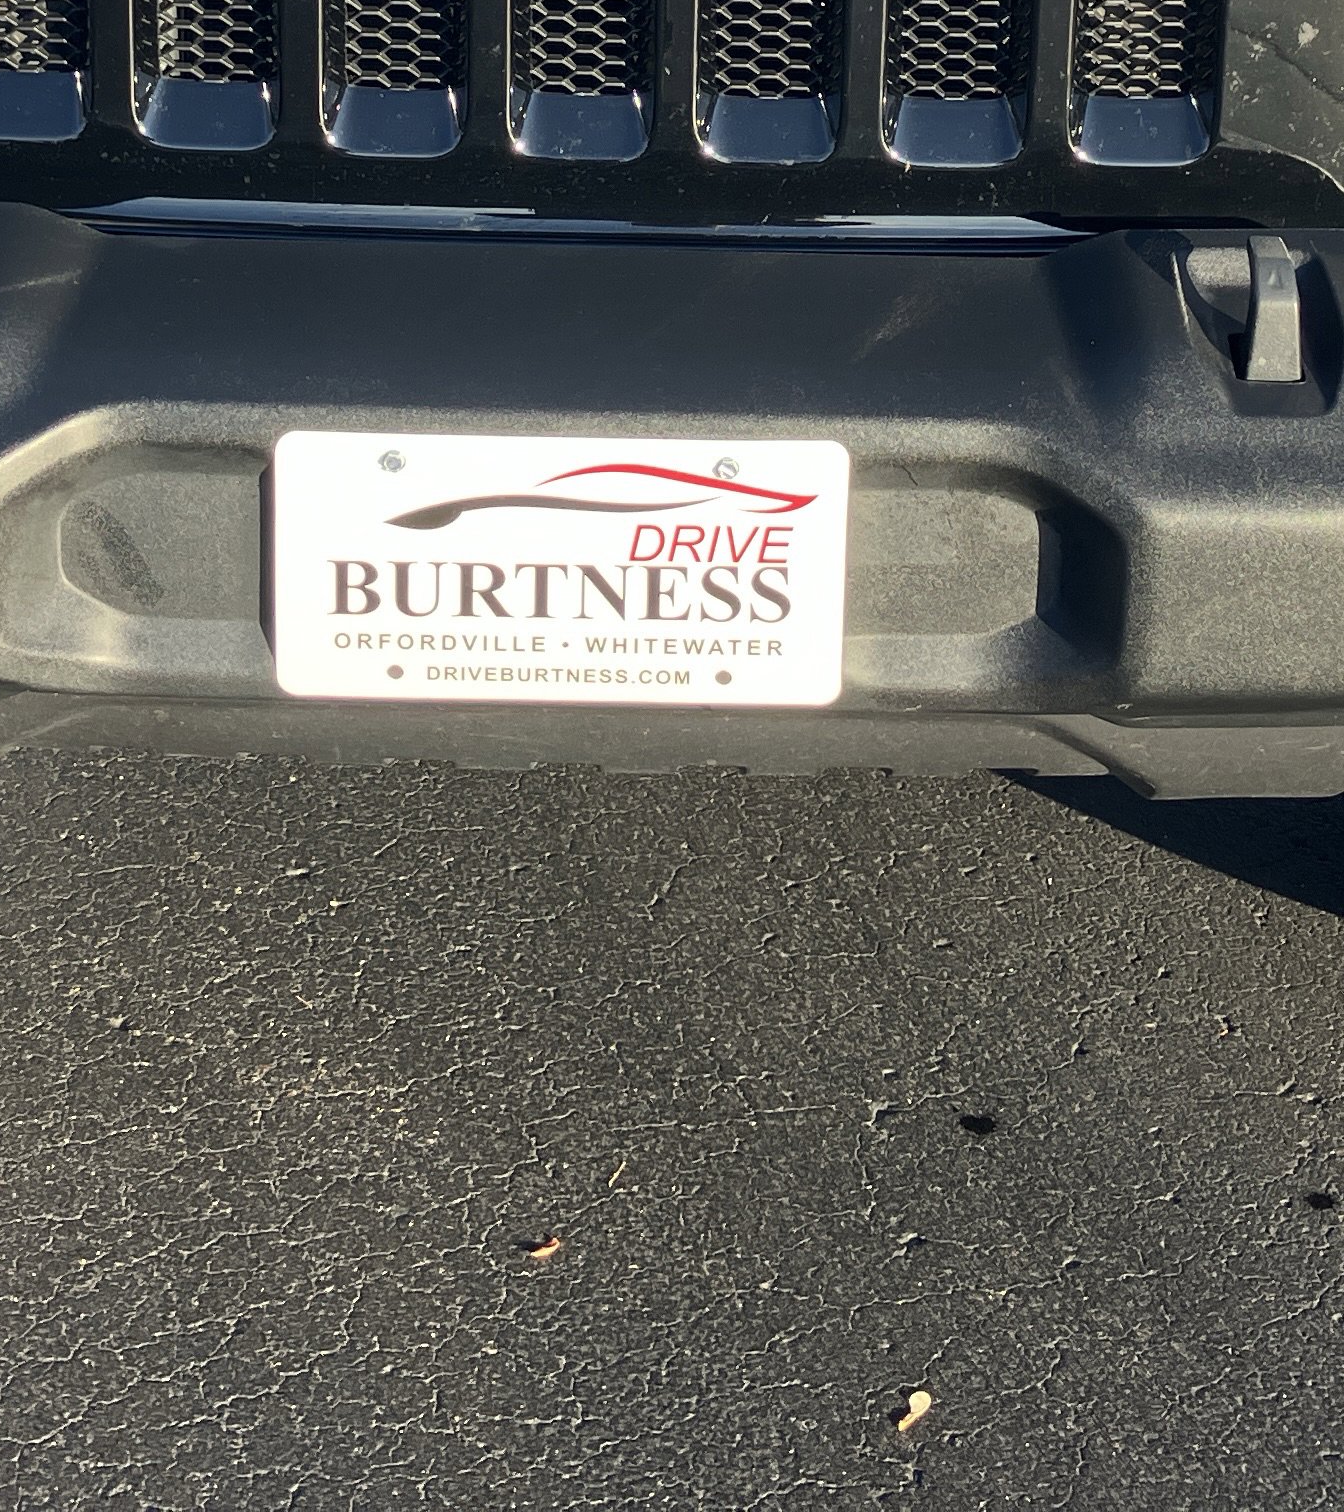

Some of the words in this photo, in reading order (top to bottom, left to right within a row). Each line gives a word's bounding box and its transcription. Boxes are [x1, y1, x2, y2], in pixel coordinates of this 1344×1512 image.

[629, 525, 794, 564] DRIVE
[327, 559, 791, 623] BURTNESS
[334, 632, 547, 653] ORFORDVILLE
[585, 637, 784, 657] WHITEWATER
[427, 665, 691, 686] DRIVEBURTNESS.COM
